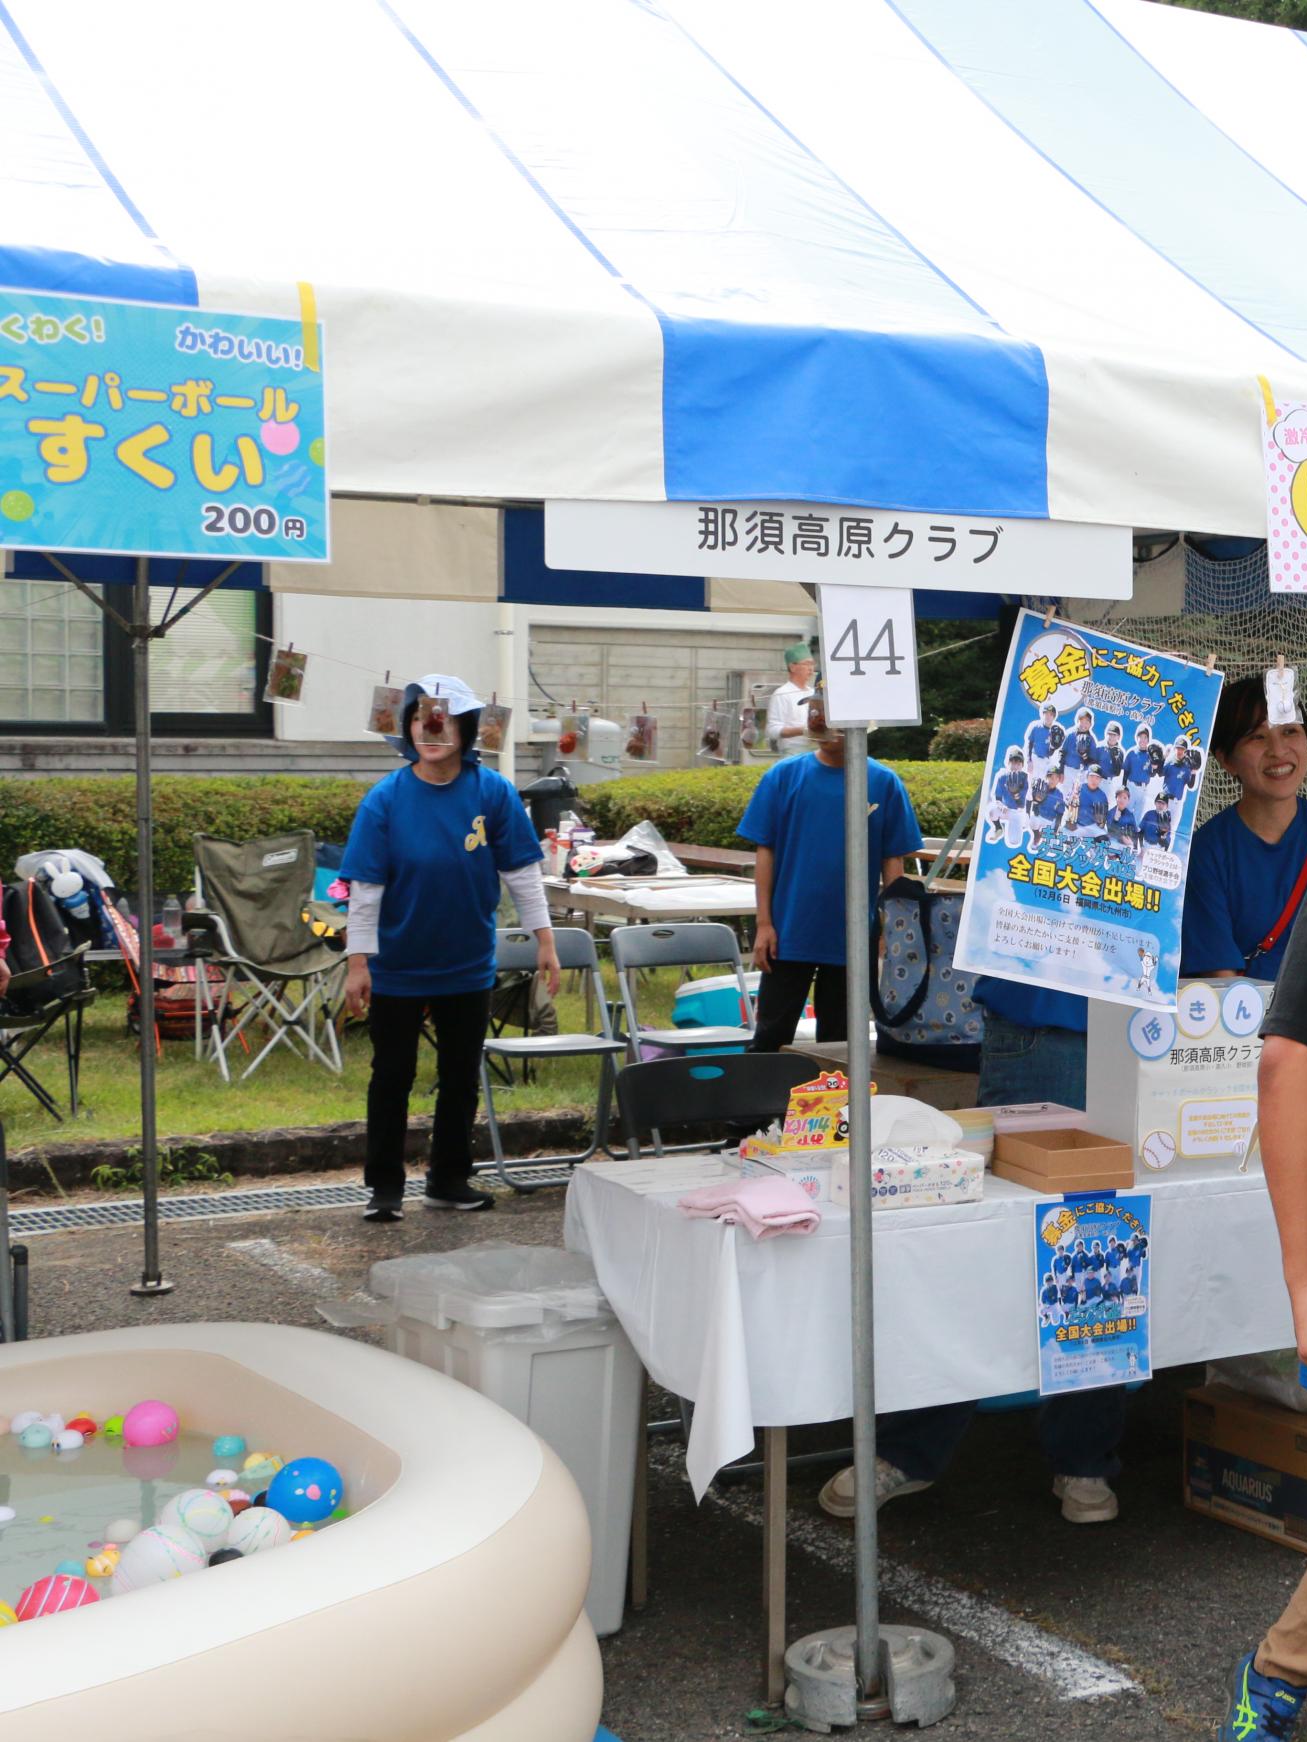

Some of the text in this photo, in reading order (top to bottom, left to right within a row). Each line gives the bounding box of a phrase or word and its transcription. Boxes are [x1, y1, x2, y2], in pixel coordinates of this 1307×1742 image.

[177, 323, 304, 370] かわいい!
[0, 366, 299, 423] スーパーボール
[27, 414, 265, 492] すくい
[202, 505, 305, 539] 200円
[697, 507, 1004, 564] 那須高原クラブ
[829, 618, 906, 677] 44
[1007, 853, 1162, 913] 全国大会出場!!
[1221, 1467, 1274, 1503] AQUARIUS
